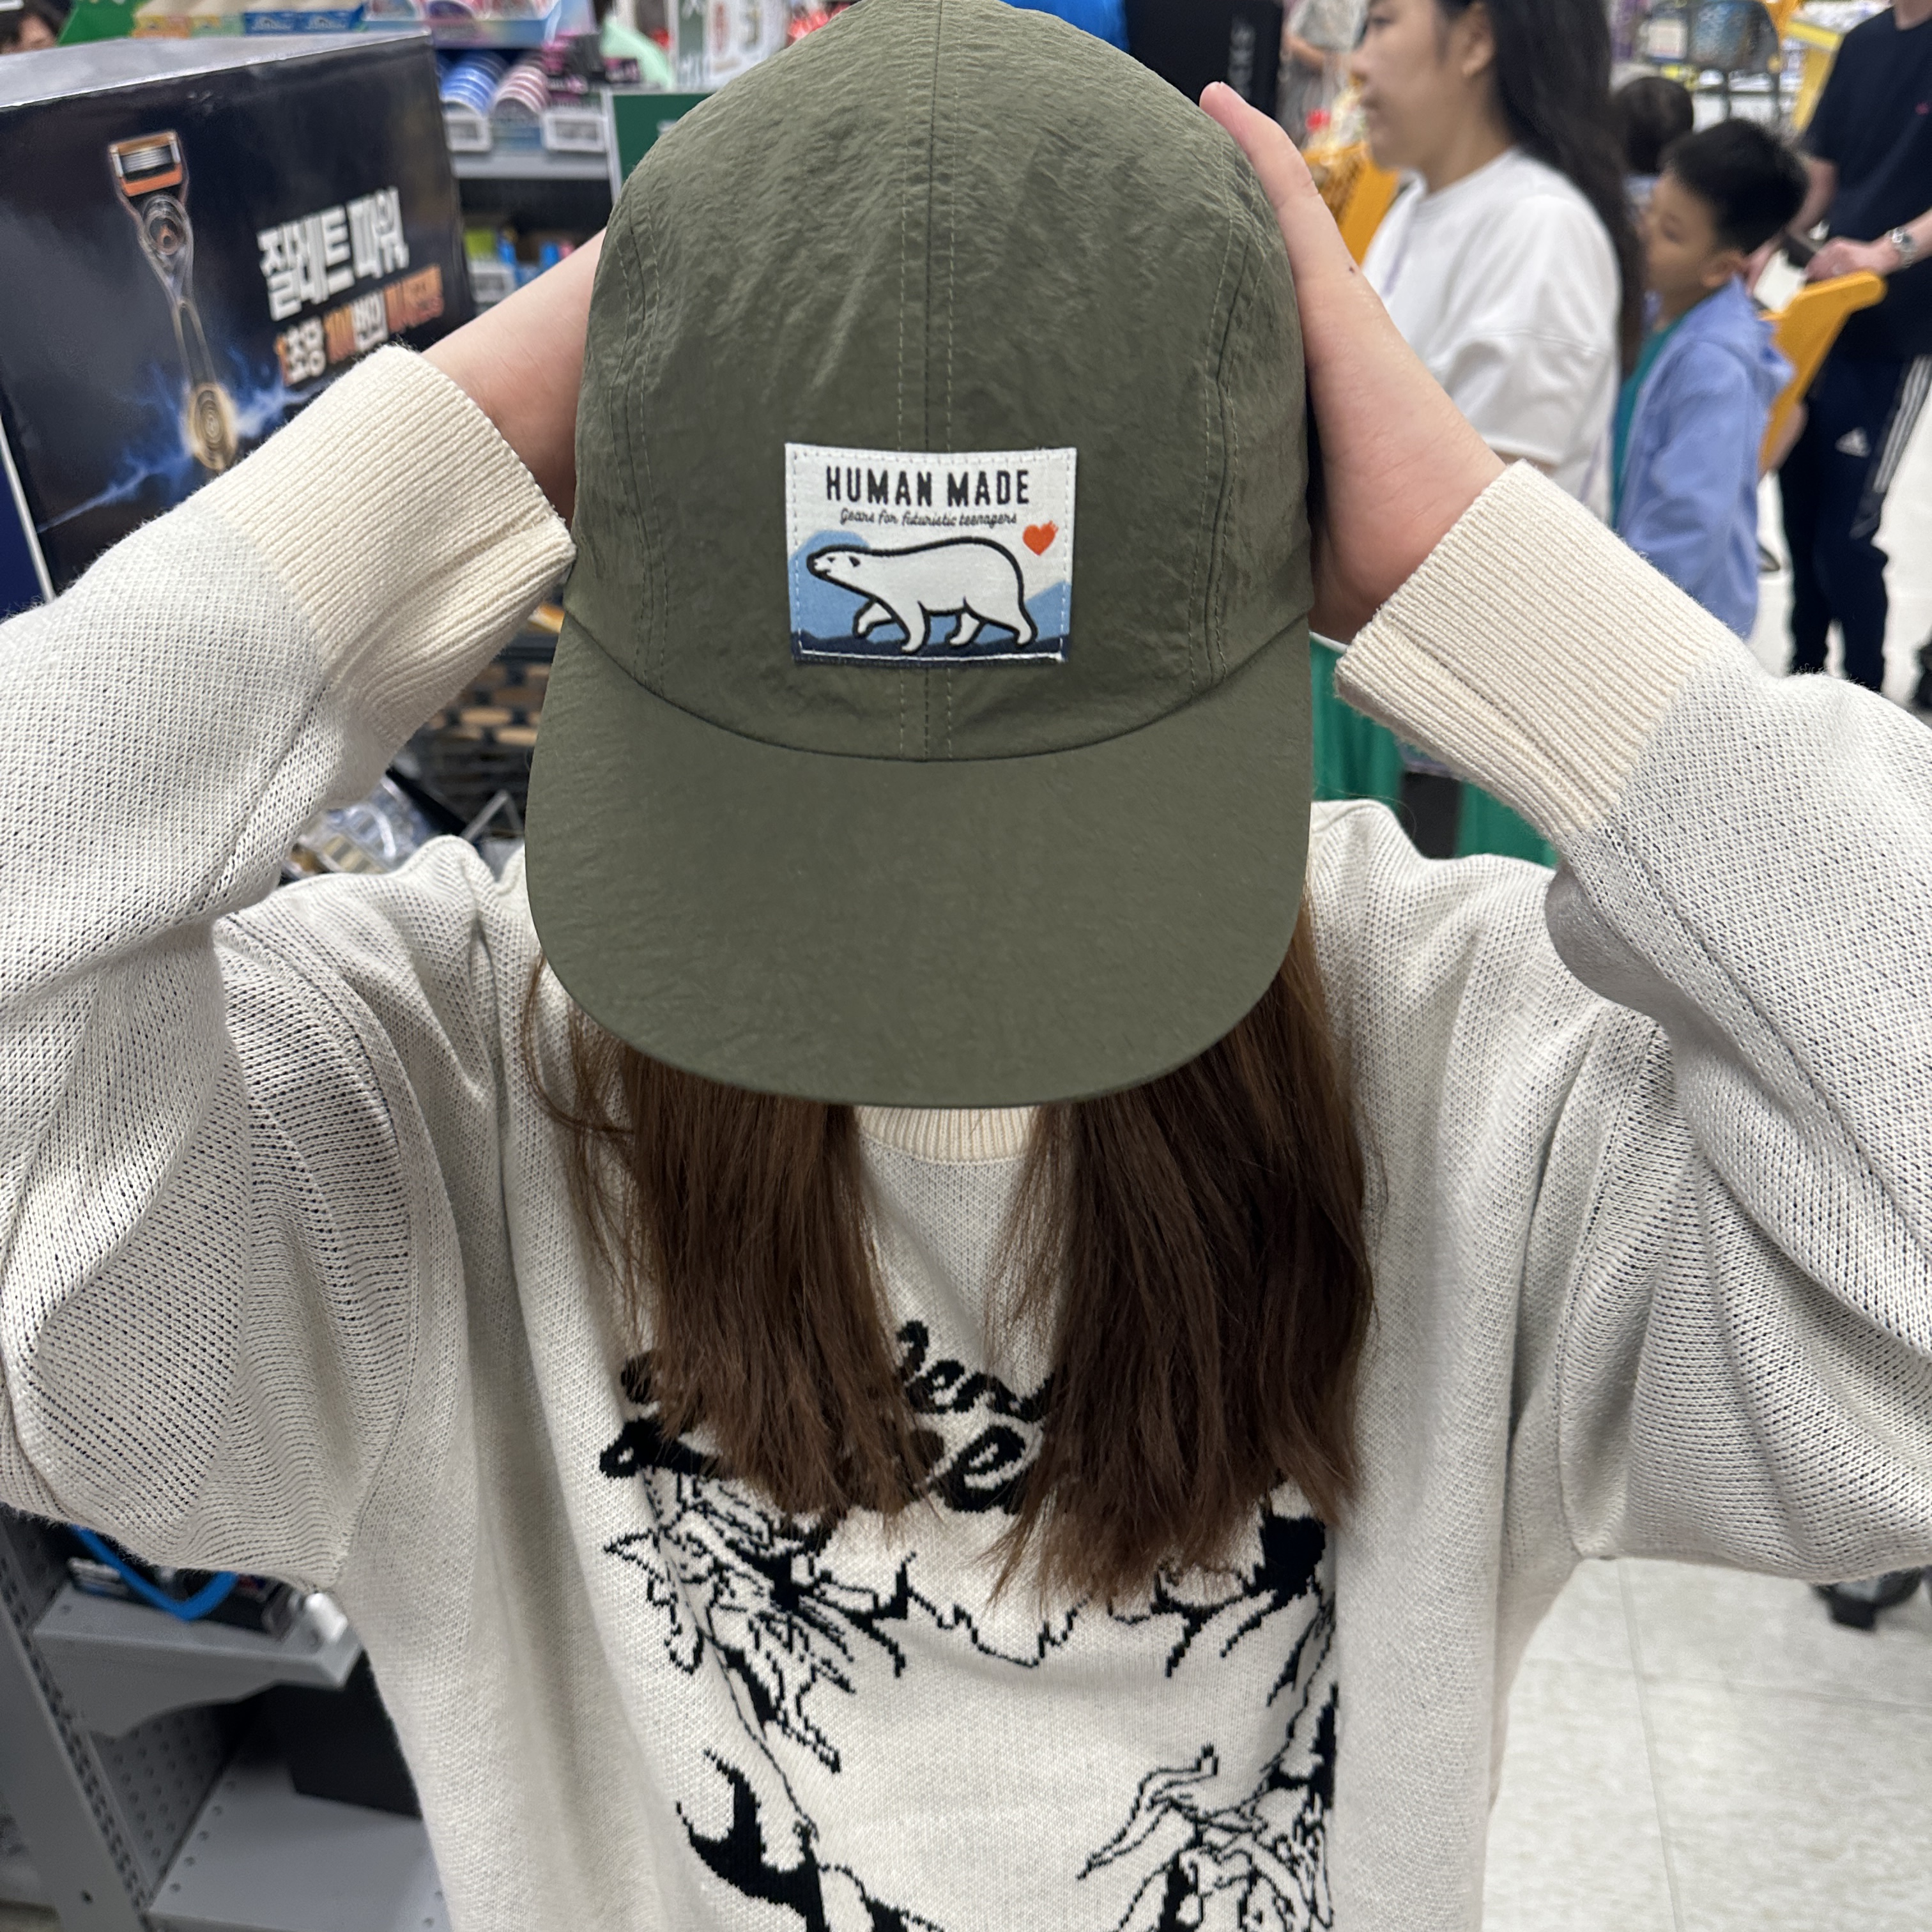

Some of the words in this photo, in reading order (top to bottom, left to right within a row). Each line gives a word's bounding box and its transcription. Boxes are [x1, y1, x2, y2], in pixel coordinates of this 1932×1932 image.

[257, 204, 355, 321] 질레트
[827, 466, 932, 507] HUMAN
[947, 470, 1029, 507] MADE
[878, 509, 898, 525] for
[959, 513, 1016, 529] teenagers
